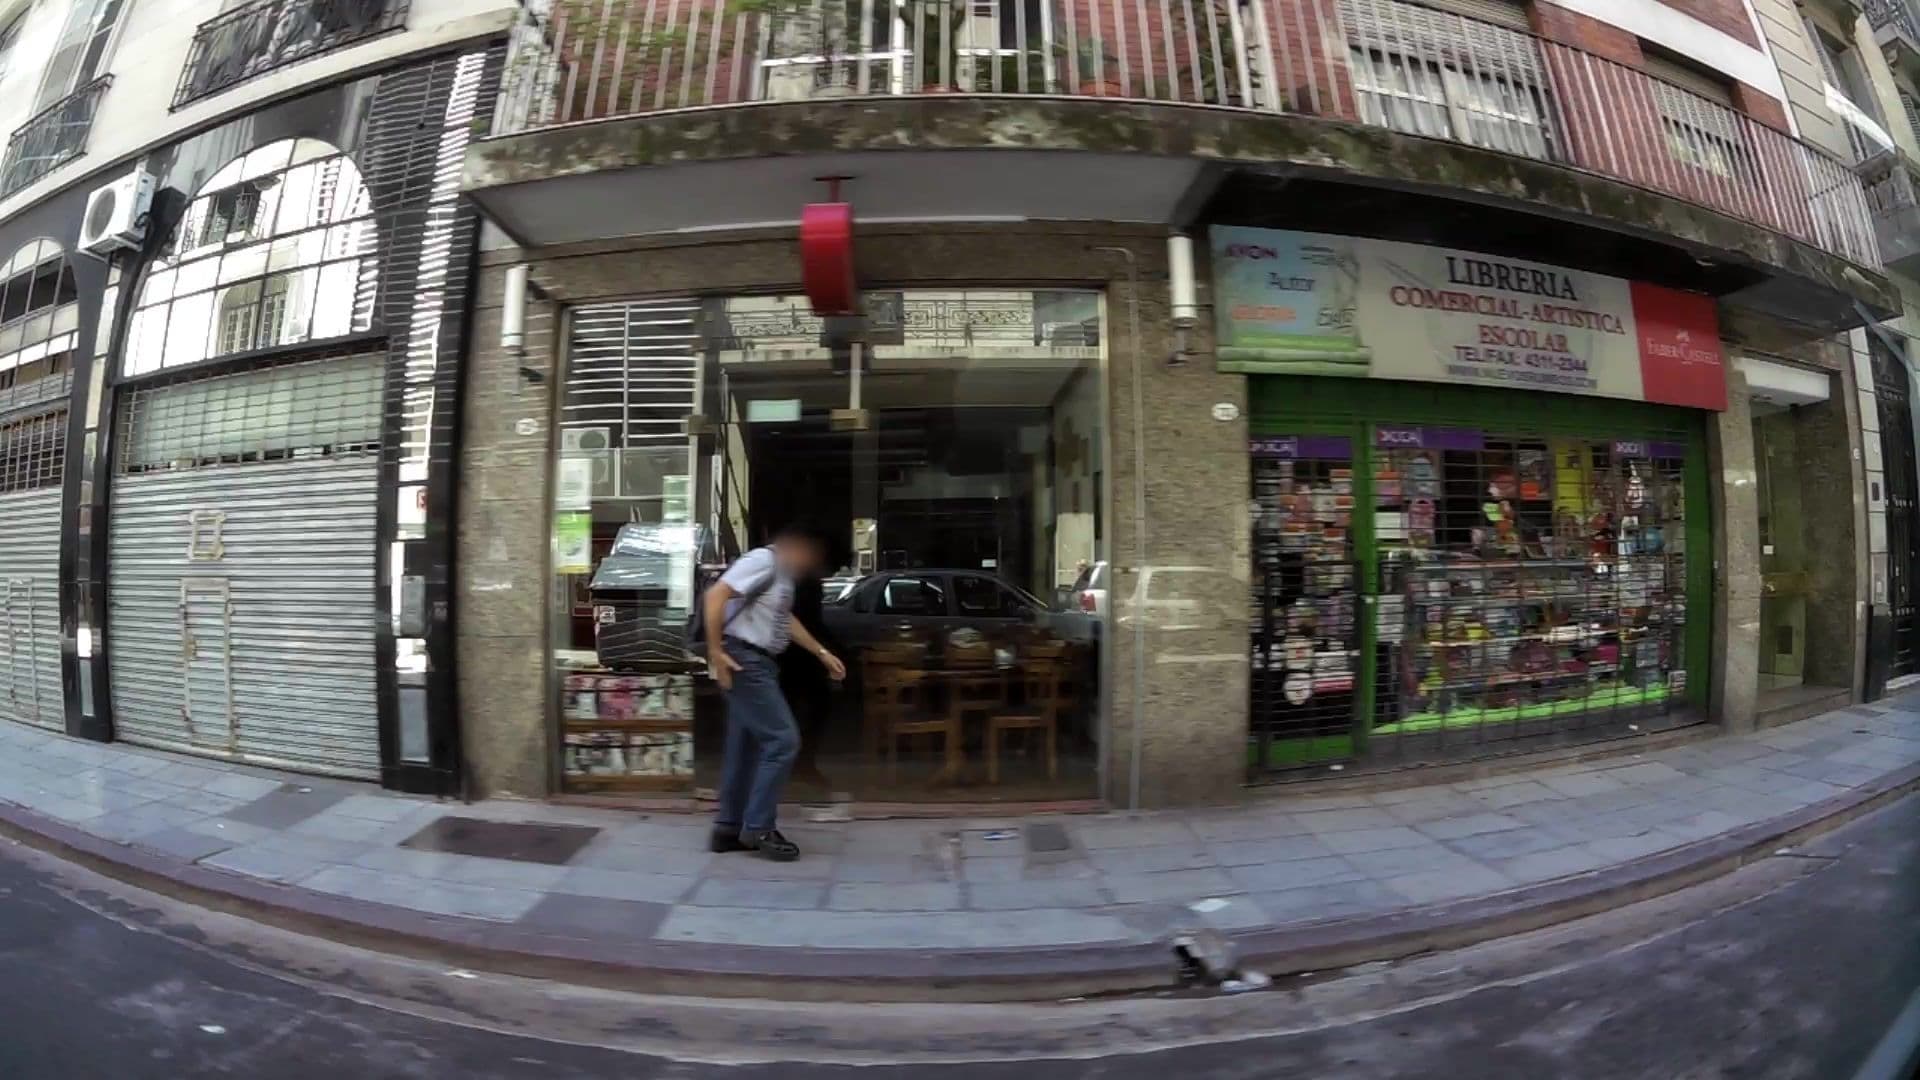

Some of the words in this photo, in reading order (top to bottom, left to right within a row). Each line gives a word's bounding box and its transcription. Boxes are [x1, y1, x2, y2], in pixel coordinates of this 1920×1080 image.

[1446, 257, 1578, 301] LIBRERIA
[1390, 286, 1624, 335] COMERCIAL-ARTISTICA
[1479, 325, 1570, 353] ESCOLAR
